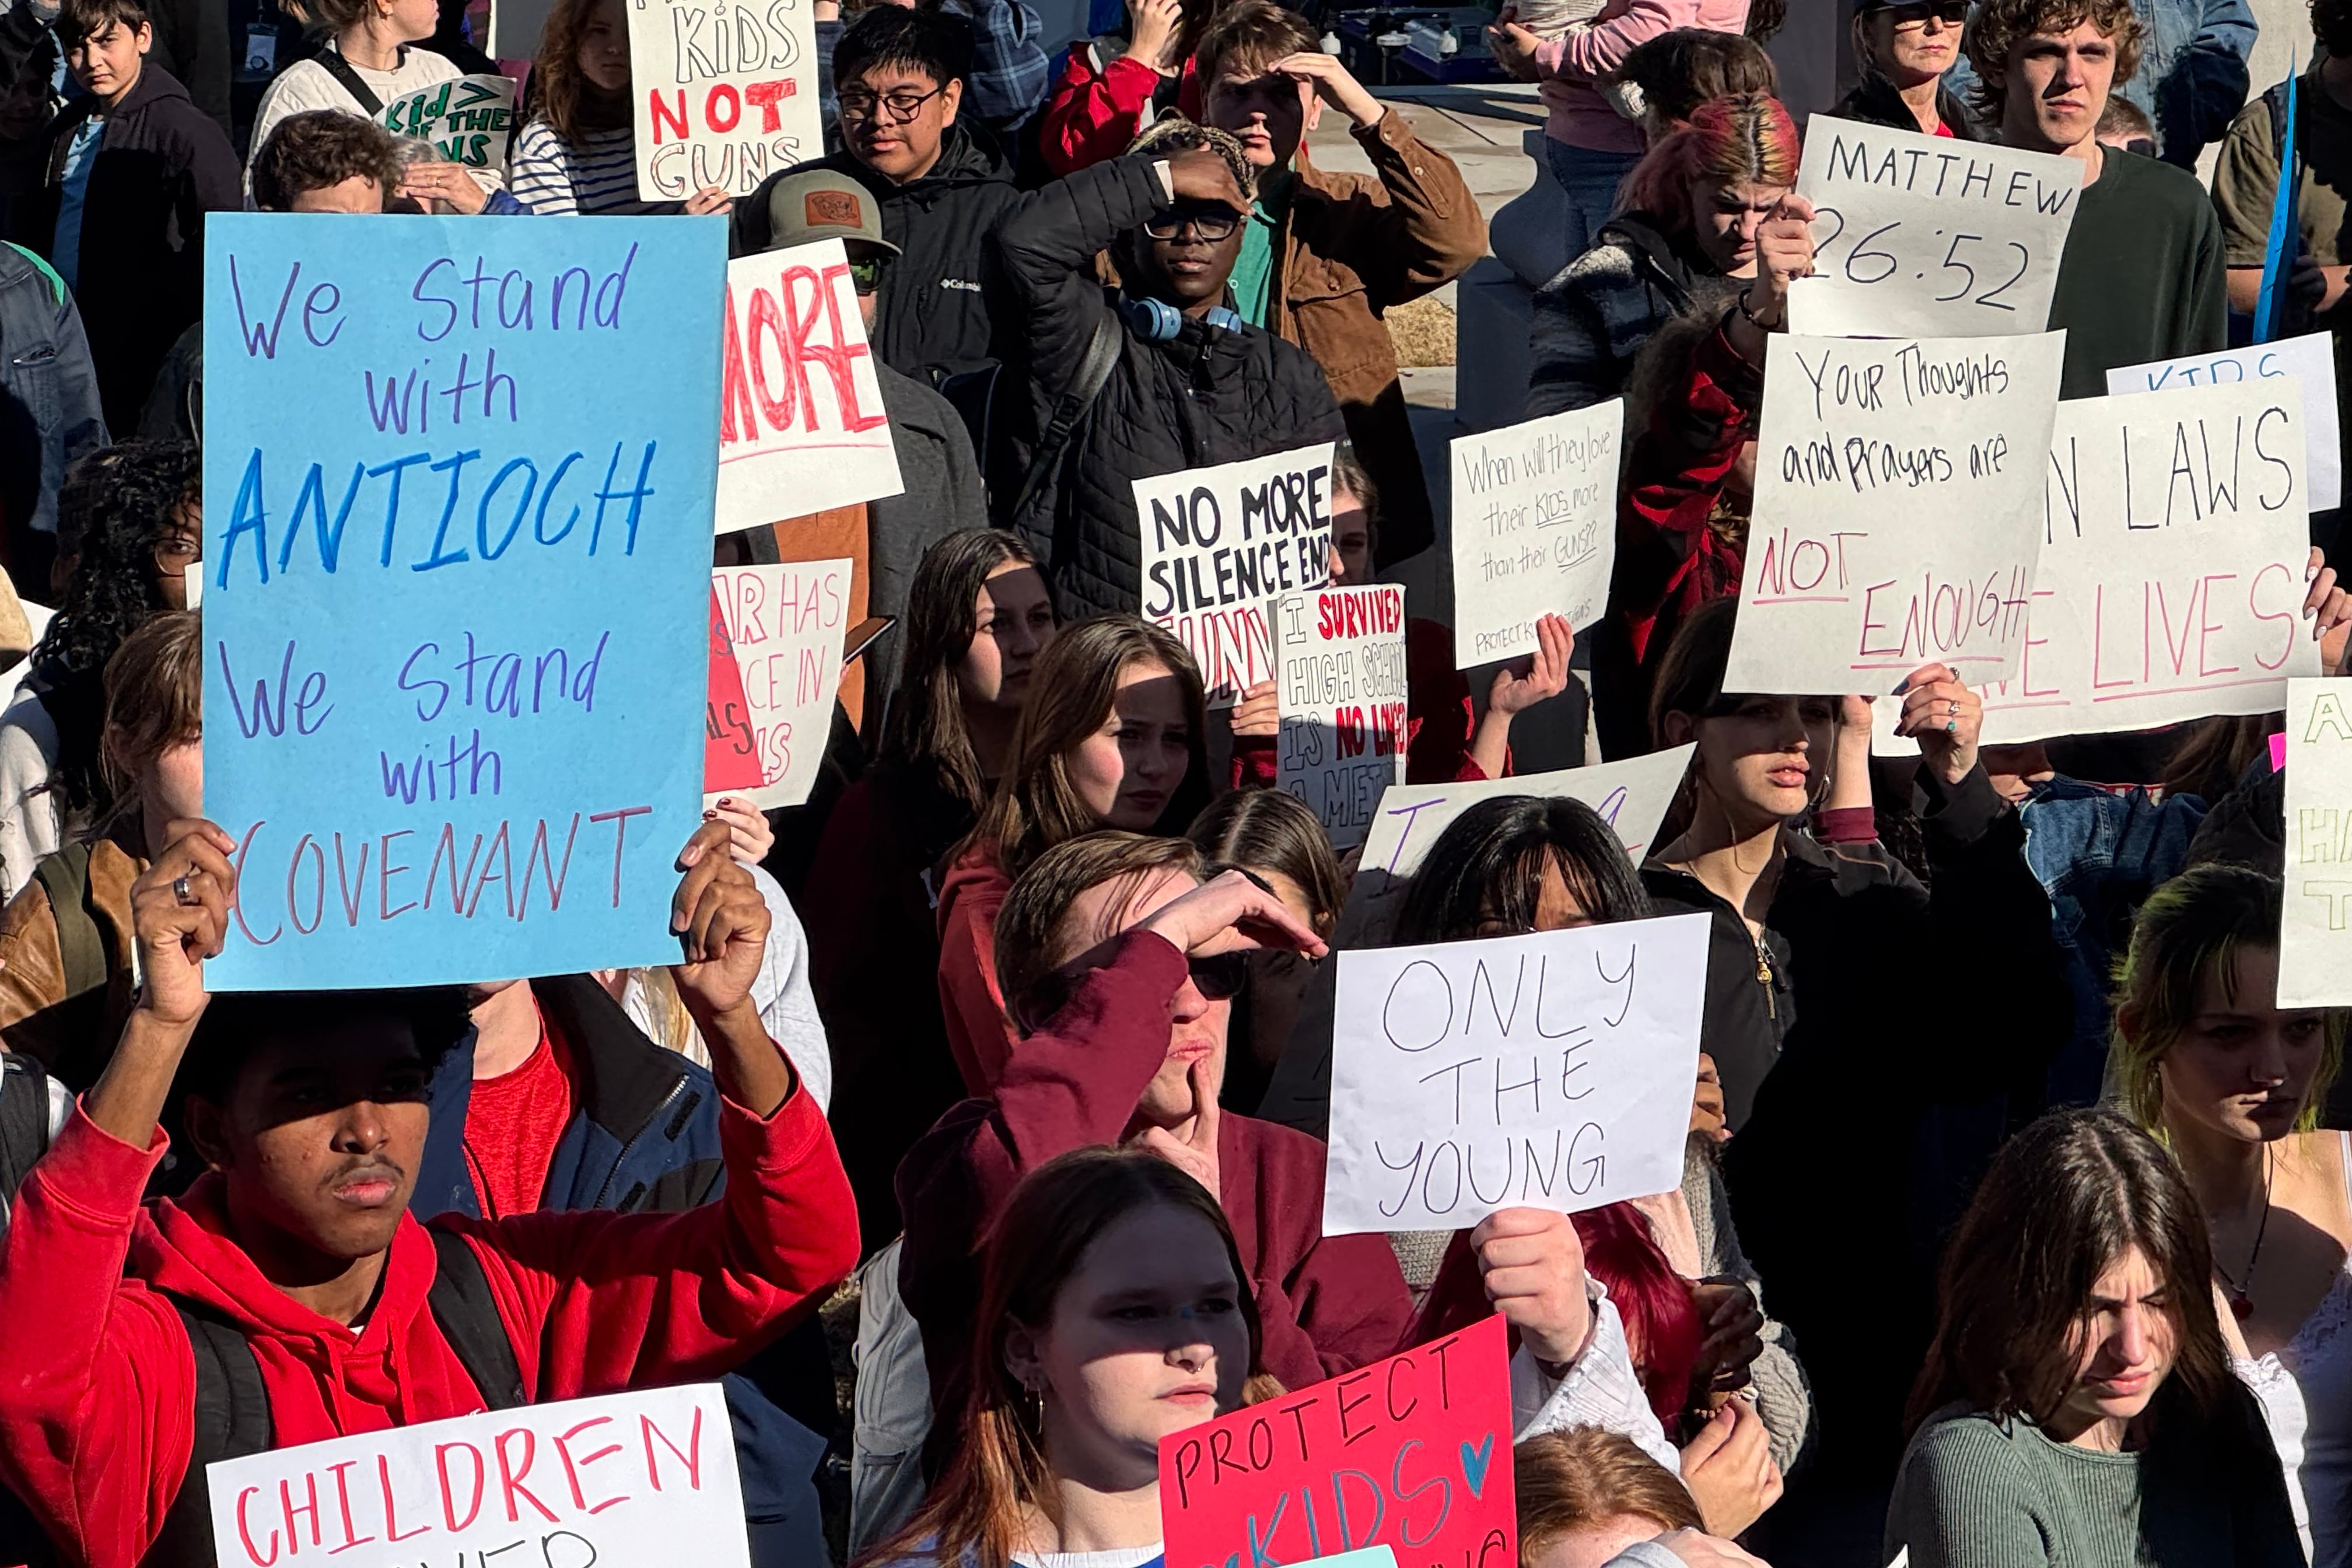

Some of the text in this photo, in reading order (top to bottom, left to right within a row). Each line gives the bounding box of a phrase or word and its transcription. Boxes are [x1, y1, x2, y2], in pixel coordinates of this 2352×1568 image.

[386, 82, 452, 132] Kid
[446, 108, 511, 133] THE
[650, 78, 797, 145] NOT
[1827, 134, 2073, 215] MATTHEW
[230, 254, 347, 359] We
[365, 348, 517, 434] with
[1462, 426, 1611, 495] When will they love
[1783, 432, 1841, 487] and
[1969, 433, 2008, 479] are
[2123, 406, 2292, 530] LAWS
[218, 440, 656, 591] ANTIOCH
[1150, 465, 1331, 553] NO MORE
[1483, 482, 1598, 537] their KIDS more
[1145, 533, 1330, 617] SILENCE END
[1480, 551, 1514, 582] than
[1518, 545, 1547, 573] their
[1757, 527, 1868, 595] NOT
[779, 572, 839, 638] HAS
[1317, 587, 1401, 640] SURVIVED
[1475, 622, 1522, 657] PROTECT
[1860, 563, 2028, 658] ENOUGH
[2094, 563, 2296, 689] LIVES
[219, 639, 335, 739] We
[796, 645, 826, 708] IN
[1287, 650, 1356, 706] HIGH
[380, 729, 501, 804] with
[1284, 711, 1323, 772] IS
[1335, 706, 1366, 761] NO
[233, 806, 653, 945] COVENANT
[1383, 943, 1636, 1052] ONLY
[1419, 1039, 1595, 1125] THE
[1374, 1122, 1606, 1217] YOUNG
[1175, 1337, 1460, 1510] PROTECT
[237, 1405, 704, 1567] CHILDREN
[1247, 1439, 1452, 1568] KIDS
